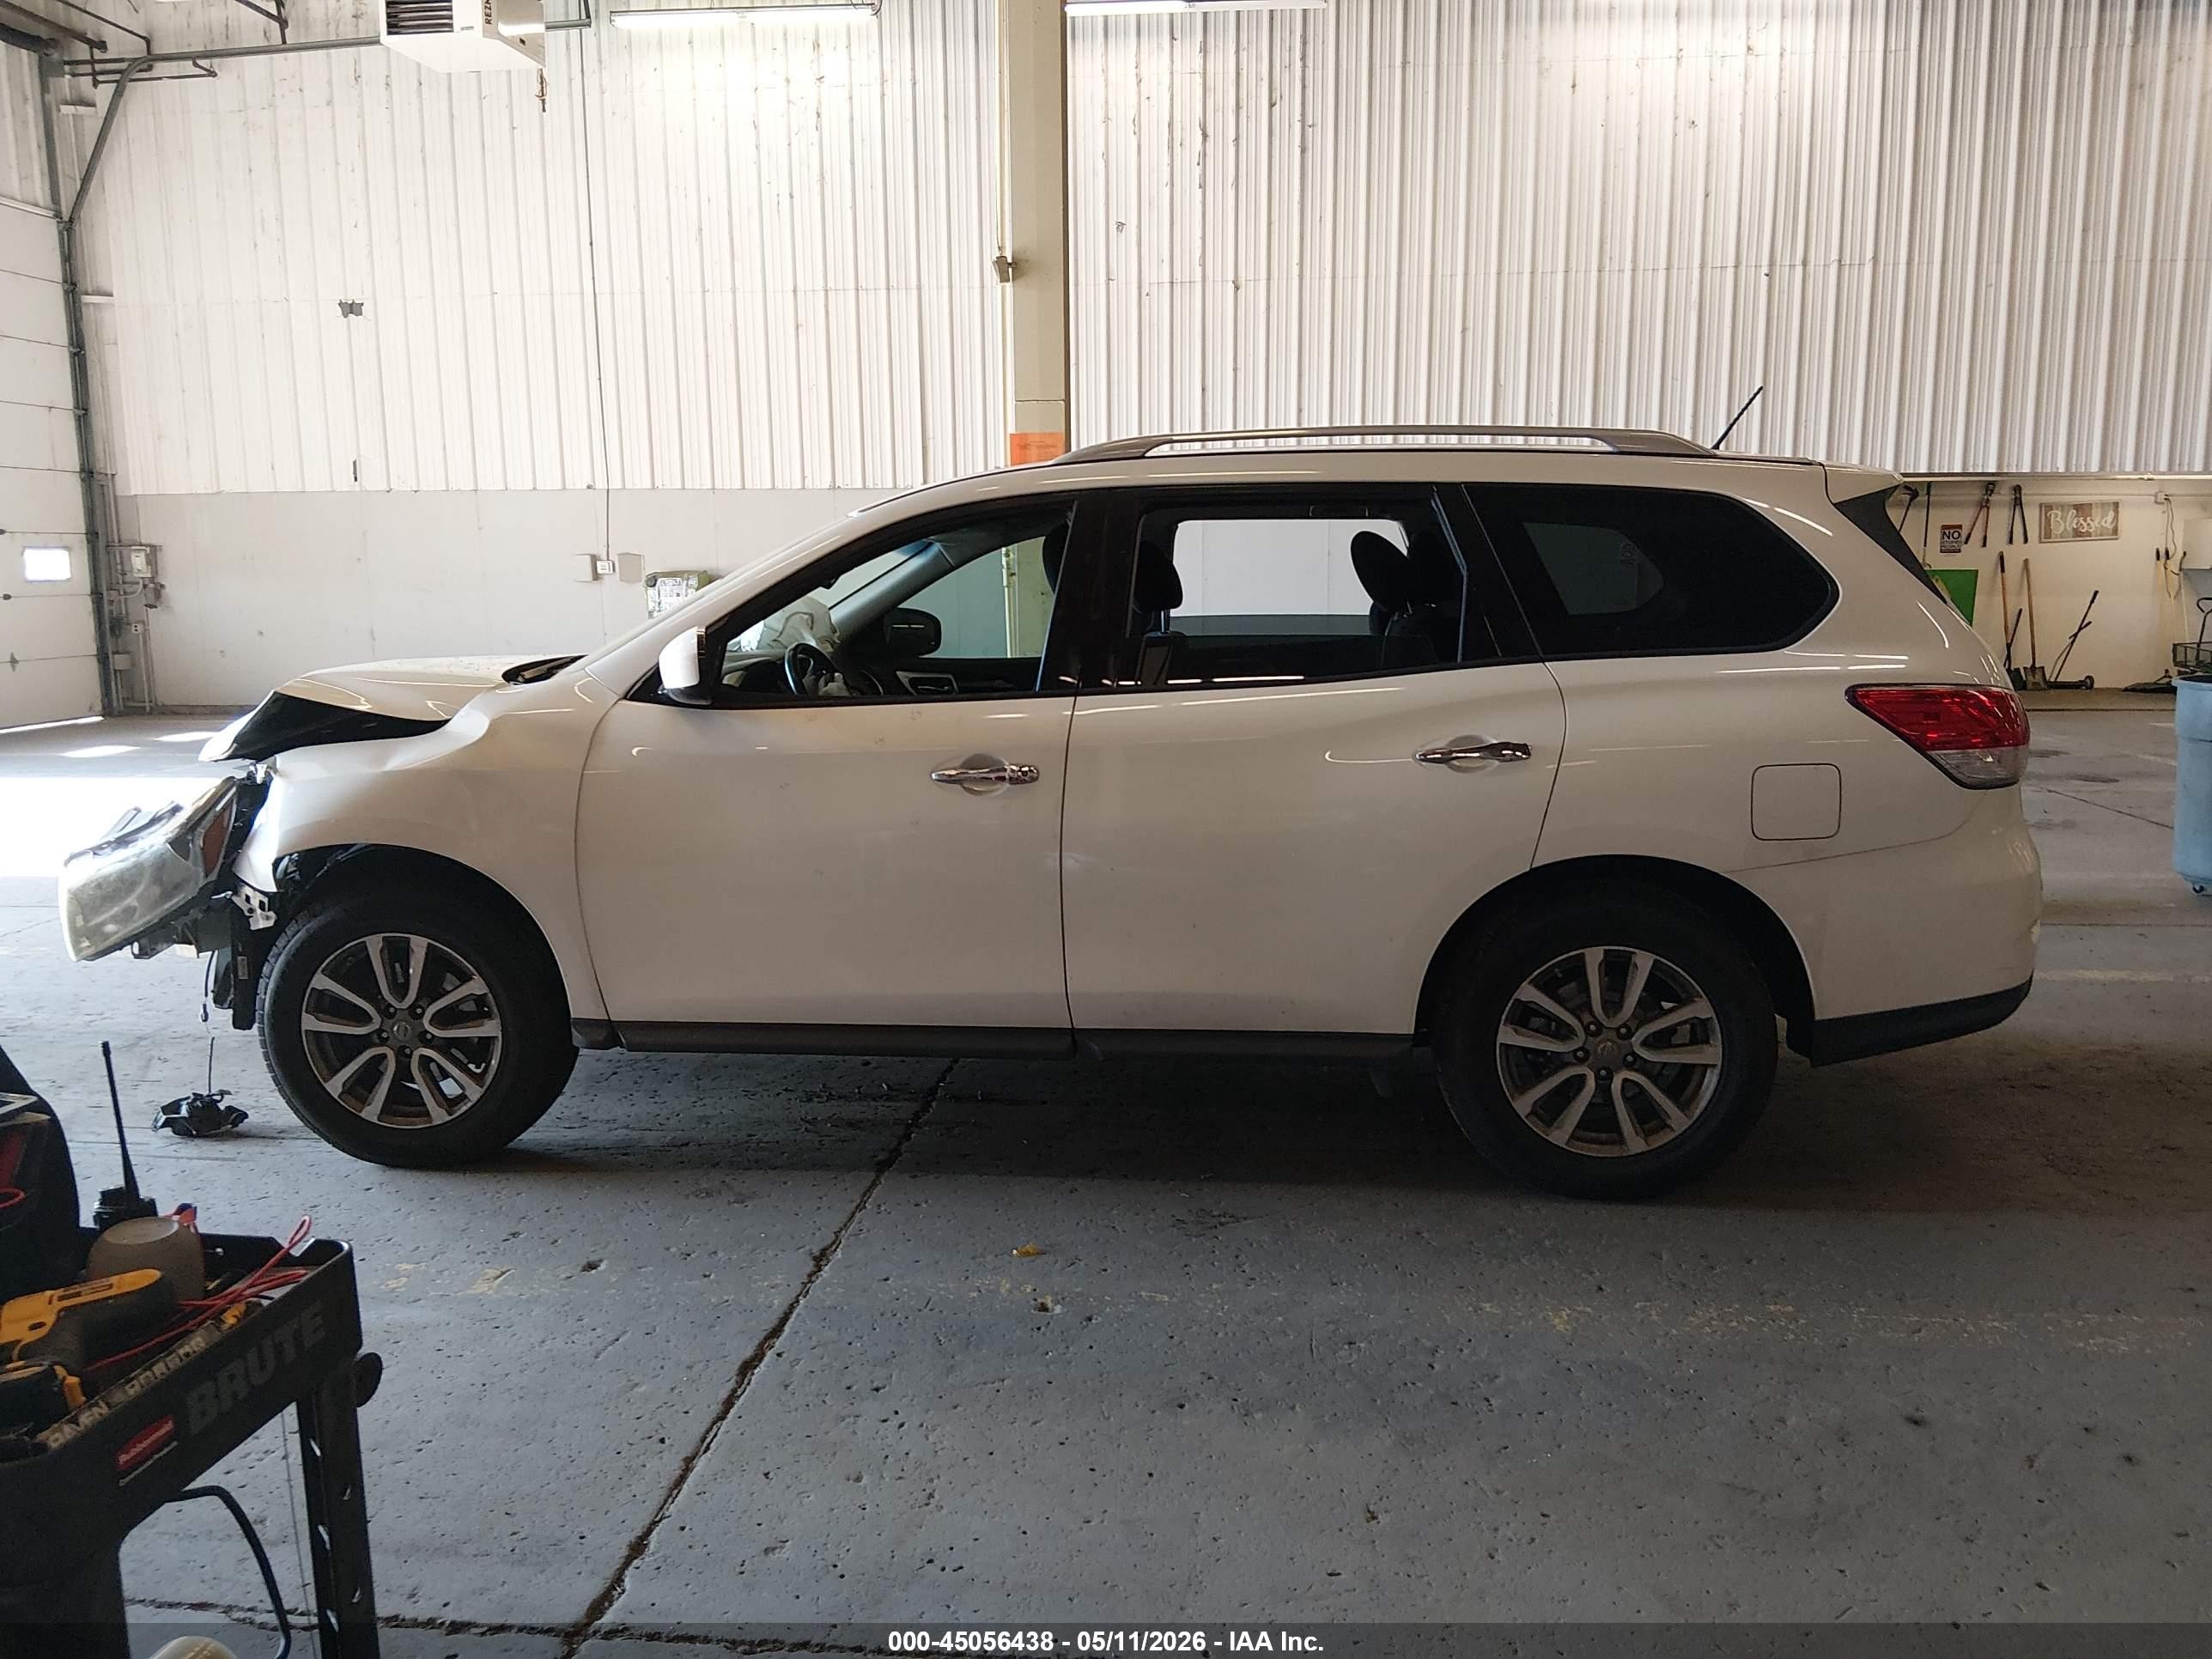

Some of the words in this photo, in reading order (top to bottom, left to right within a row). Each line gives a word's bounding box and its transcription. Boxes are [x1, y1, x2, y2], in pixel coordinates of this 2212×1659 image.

[2047, 509, 2117, 533] Blessed
[1942, 530, 1961, 540] NO
[186, 1300, 325, 1436] BRUTE
